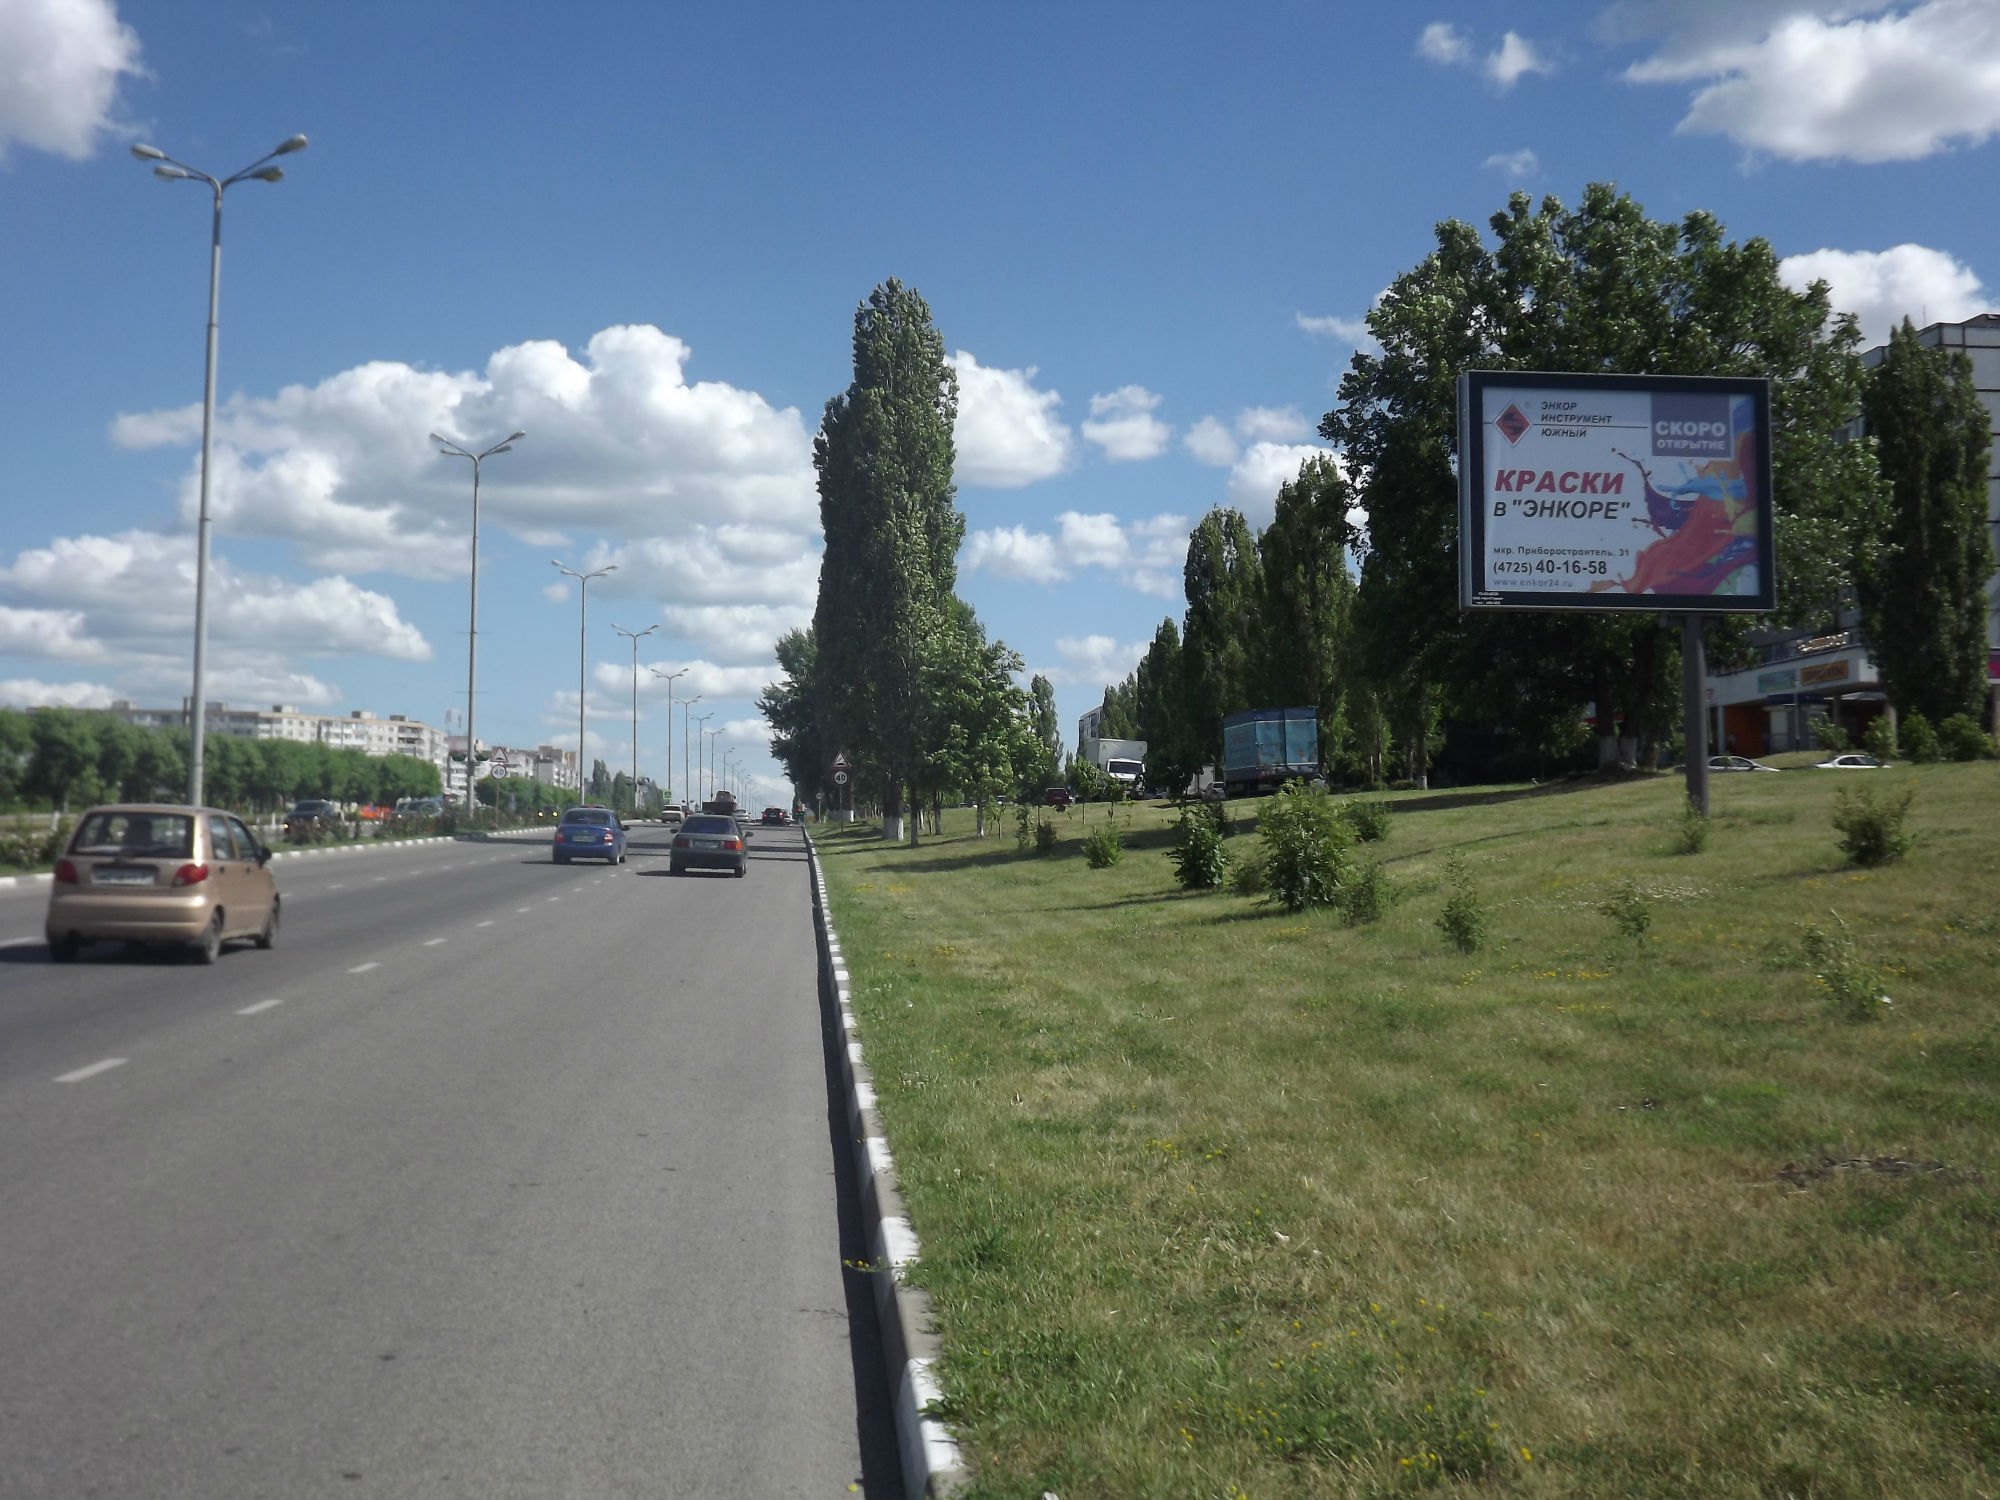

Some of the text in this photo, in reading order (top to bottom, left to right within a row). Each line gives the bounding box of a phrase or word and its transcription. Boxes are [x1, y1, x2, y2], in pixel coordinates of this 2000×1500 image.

[1541, 401, 1577, 411] ЭНКОР
[1541, 414, 1613, 424] ИНСТРУМЕНТ
[1541, 428, 1587, 438] ЮЖНЫЙ
[1655, 420, 1726, 437] СКОРО
[1656, 439, 1726, 450] ОТКРЫТИЕ
[1495, 470, 1624, 494] КРАСКИ
[1512, 500, 1630, 519] "ЭНКОРЕ"
[1493, 547, 1515, 556] мкр.
[1618, 548, 1630, 557] 31
[1493, 559, 1608, 575] (4725) 40-16-58
[1493, 579, 1573, 587] www.enkor24.ru
